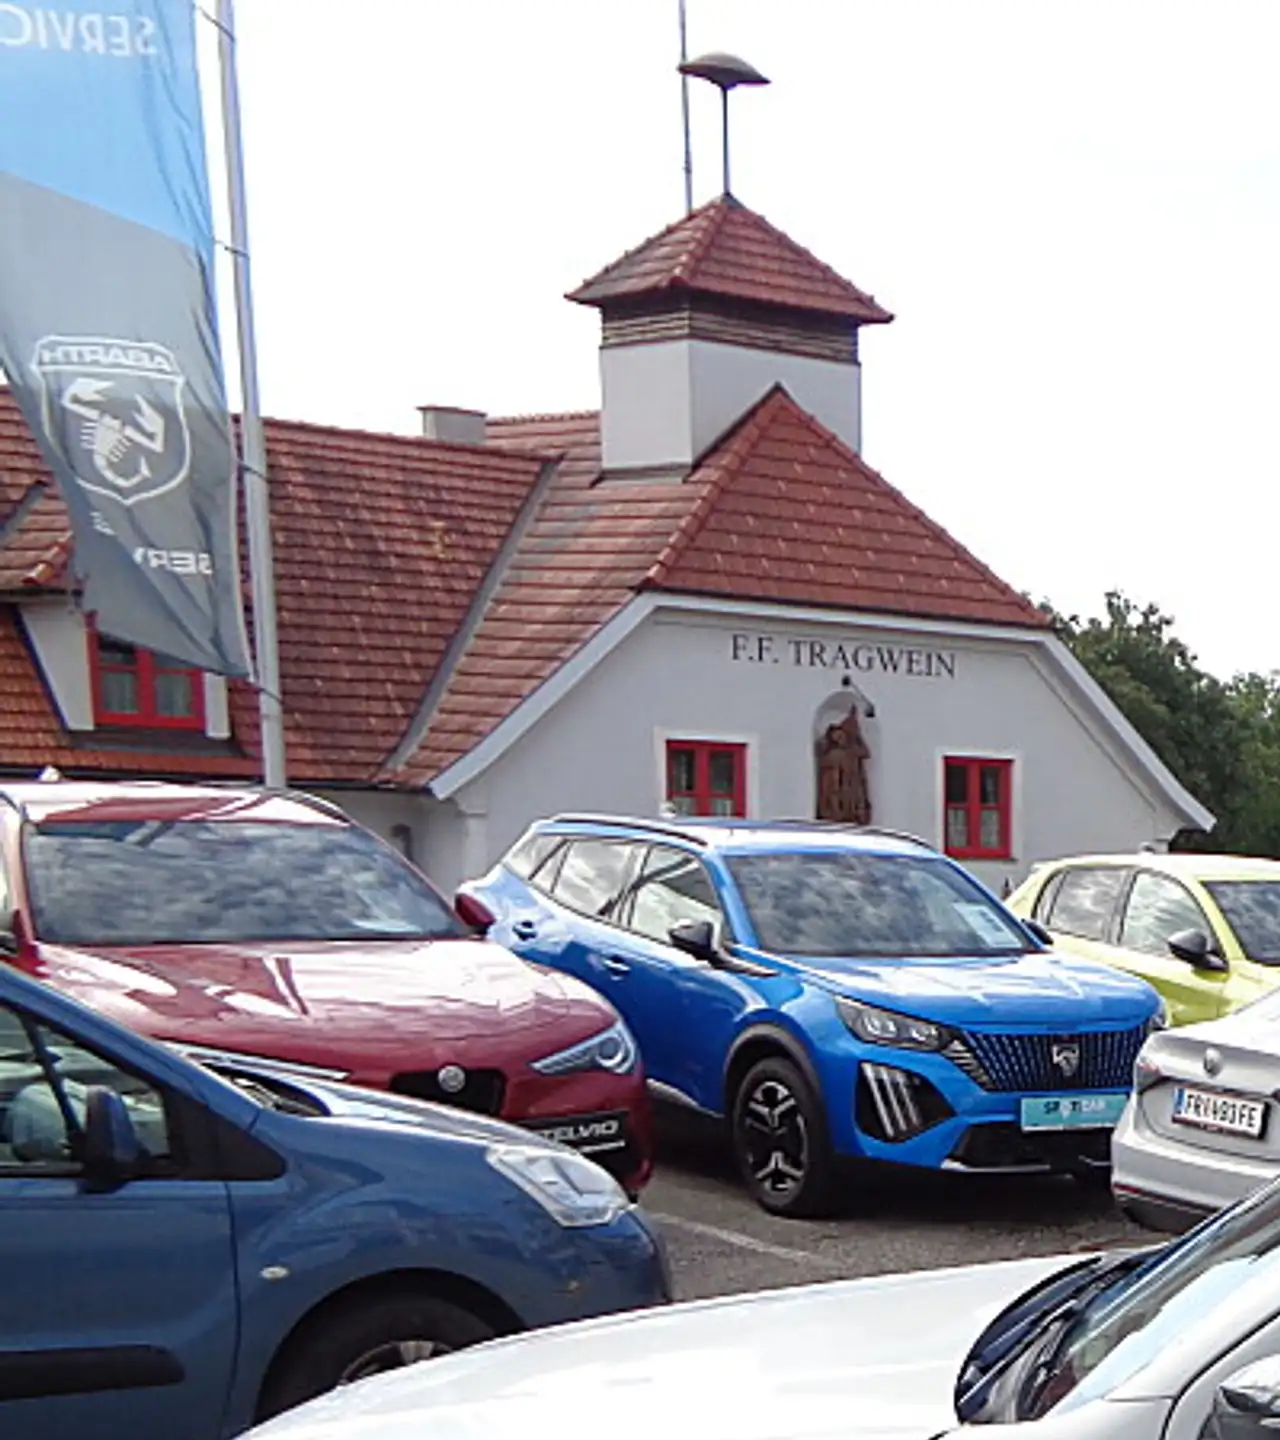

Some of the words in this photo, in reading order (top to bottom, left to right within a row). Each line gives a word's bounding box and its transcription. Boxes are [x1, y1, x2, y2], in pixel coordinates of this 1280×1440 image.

[731, 634, 779, 663] F.F.
[788, 639, 956, 678] TRAGWEIN
[540, 1119, 620, 1142] TELVIO
